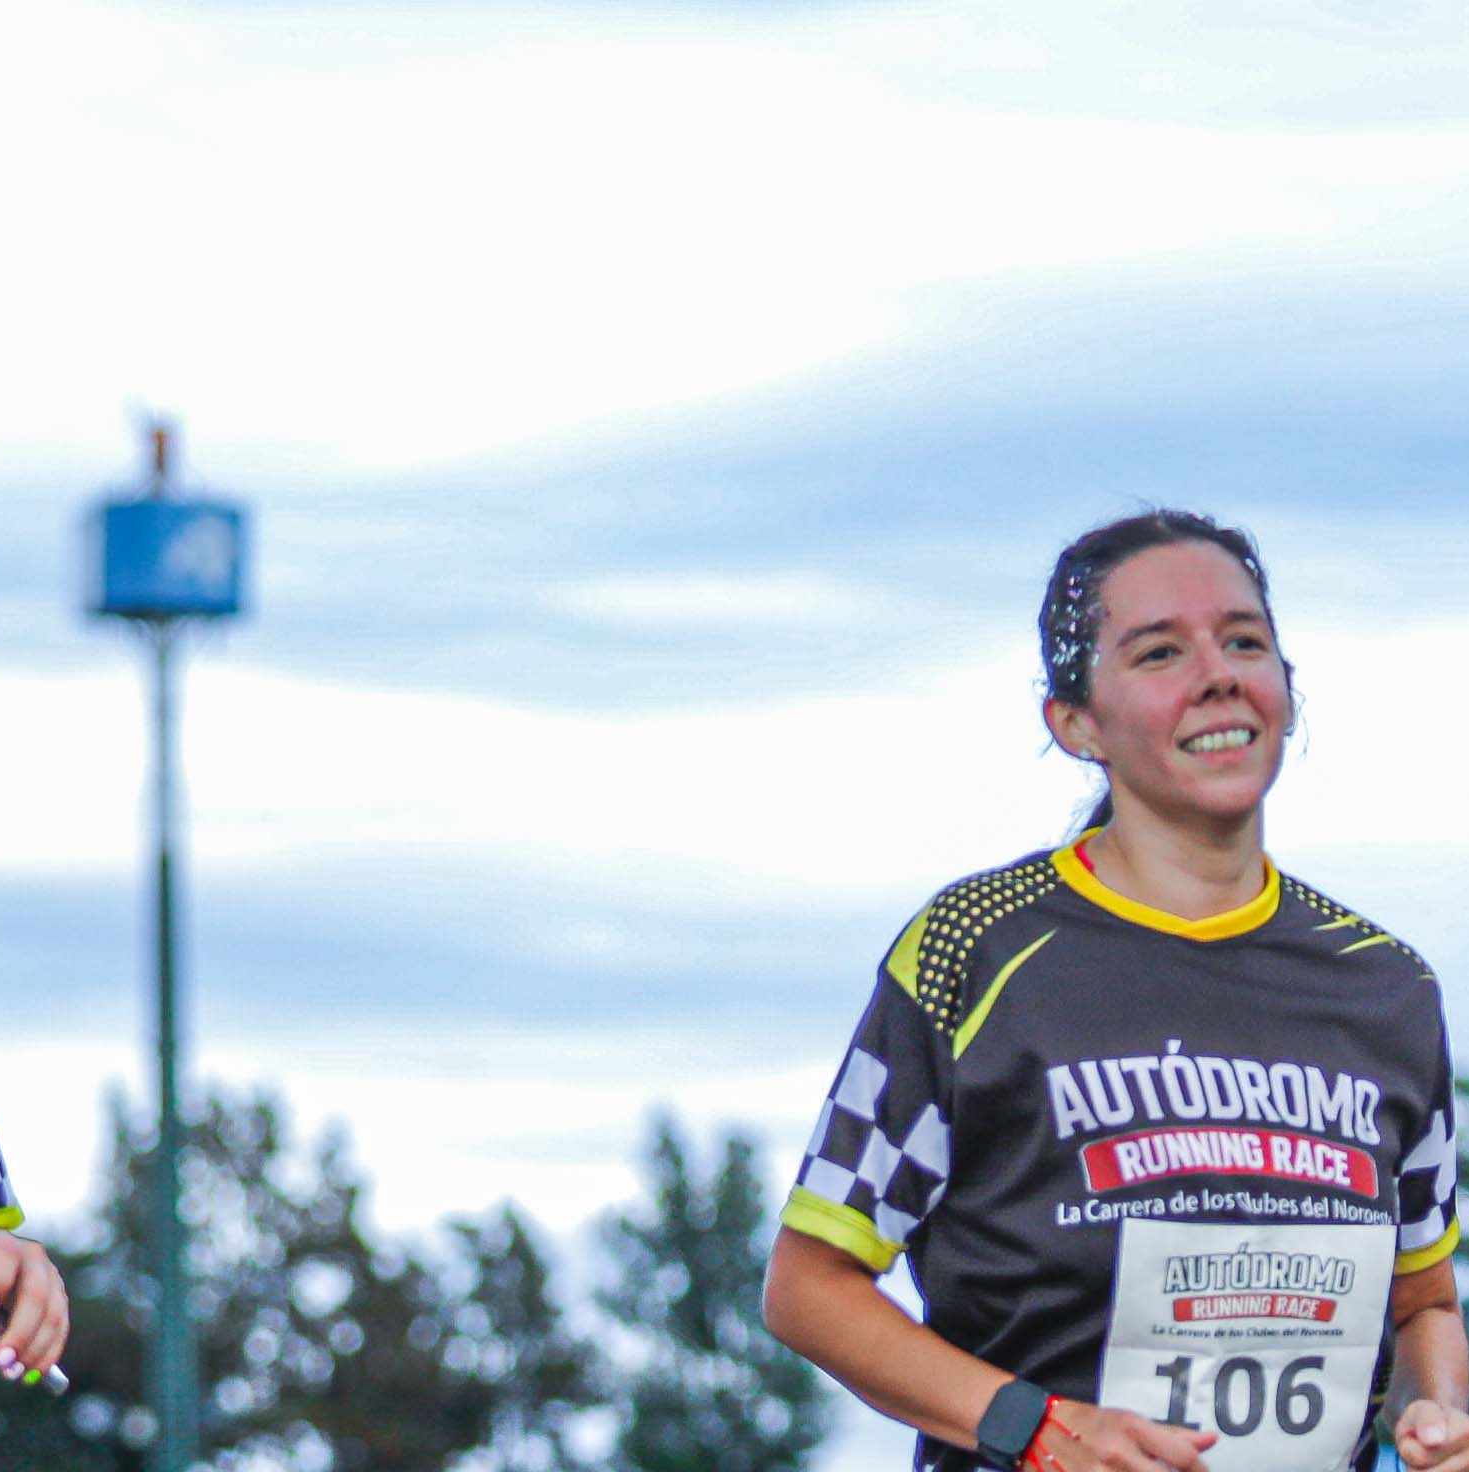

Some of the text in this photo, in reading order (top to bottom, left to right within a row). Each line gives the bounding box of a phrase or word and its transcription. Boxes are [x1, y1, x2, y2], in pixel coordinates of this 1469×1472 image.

[1046, 1039, 1381, 1146] AUTÓDROMO
[1114, 1131, 1351, 1186] RUNNING RACE
[1057, 1202, 1081, 1226] La
[1084, 1197, 1165, 1222] Carrera
[1170, 1190, 1198, 1214] de
[1202, 1188, 1235, 1211] los
[1300, 1196, 1329, 1218] del
[1163, 1242, 1355, 1295] AUTÓDROMO
[1191, 1295, 1319, 1319] RUNNING RACE
[1152, 1355, 1326, 1437] 106
